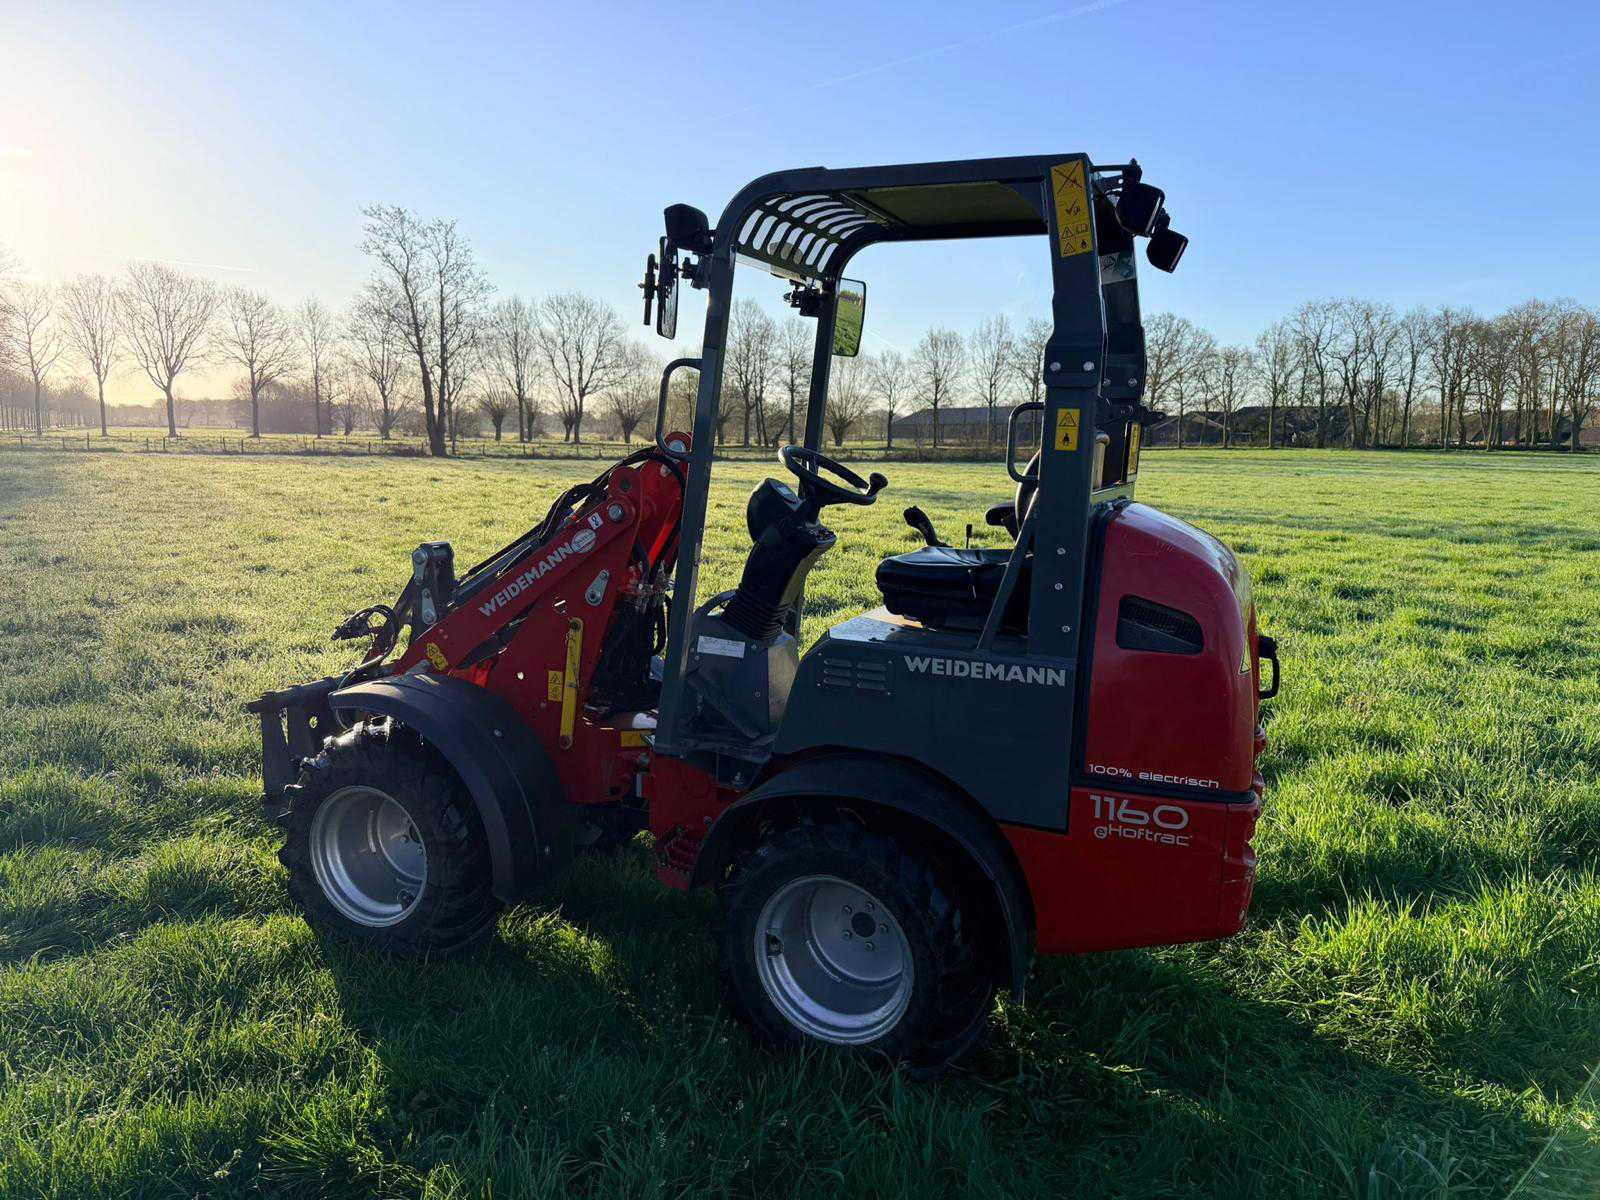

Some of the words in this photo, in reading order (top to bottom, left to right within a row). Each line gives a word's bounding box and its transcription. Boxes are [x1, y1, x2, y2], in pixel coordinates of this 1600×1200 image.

[478, 542, 576, 617] WEIDEMANN
[903, 655, 1066, 687] WEIDEMANN
[1088, 763, 1132, 778] 100%
[1138, 771, 1219, 789] electrisch
[1089, 794, 1189, 830] 1160
